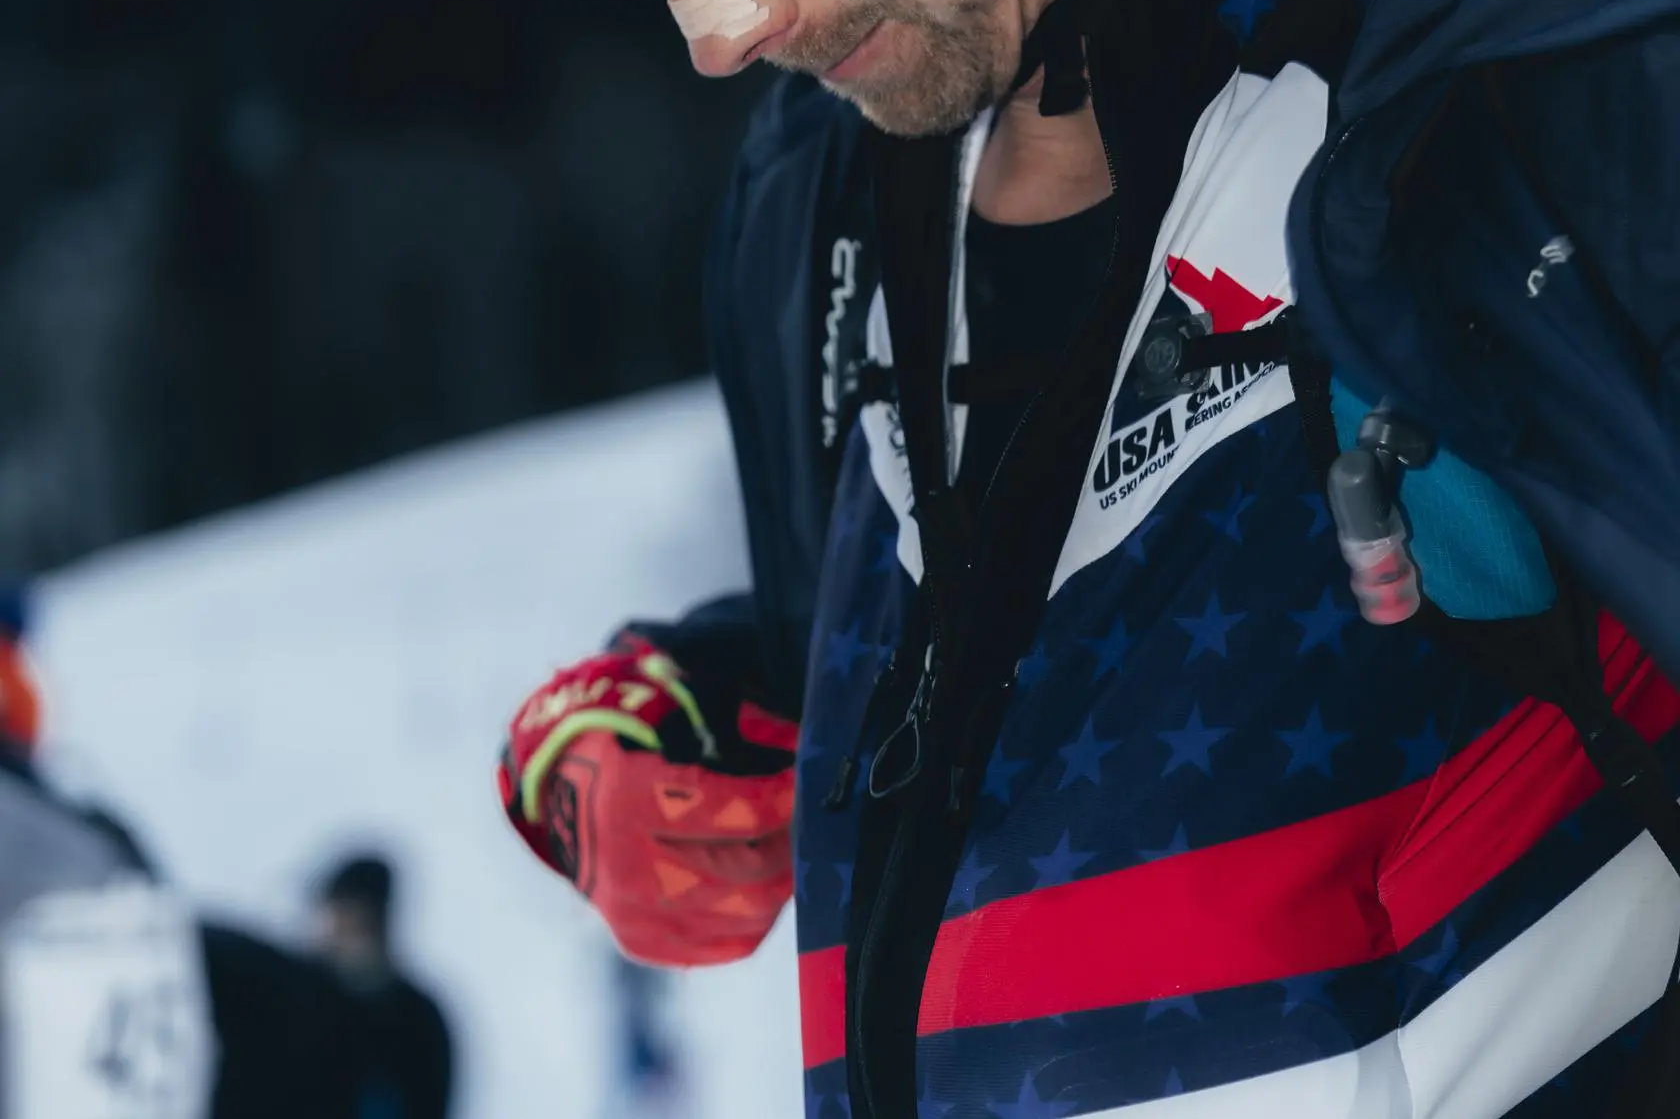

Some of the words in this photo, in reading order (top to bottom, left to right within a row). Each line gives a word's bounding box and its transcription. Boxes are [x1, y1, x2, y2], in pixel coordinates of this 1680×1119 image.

[1093, 407, 1176, 493] USA
[1099, 492, 1118, 511] US
[1119, 479, 1138, 501] SKI
